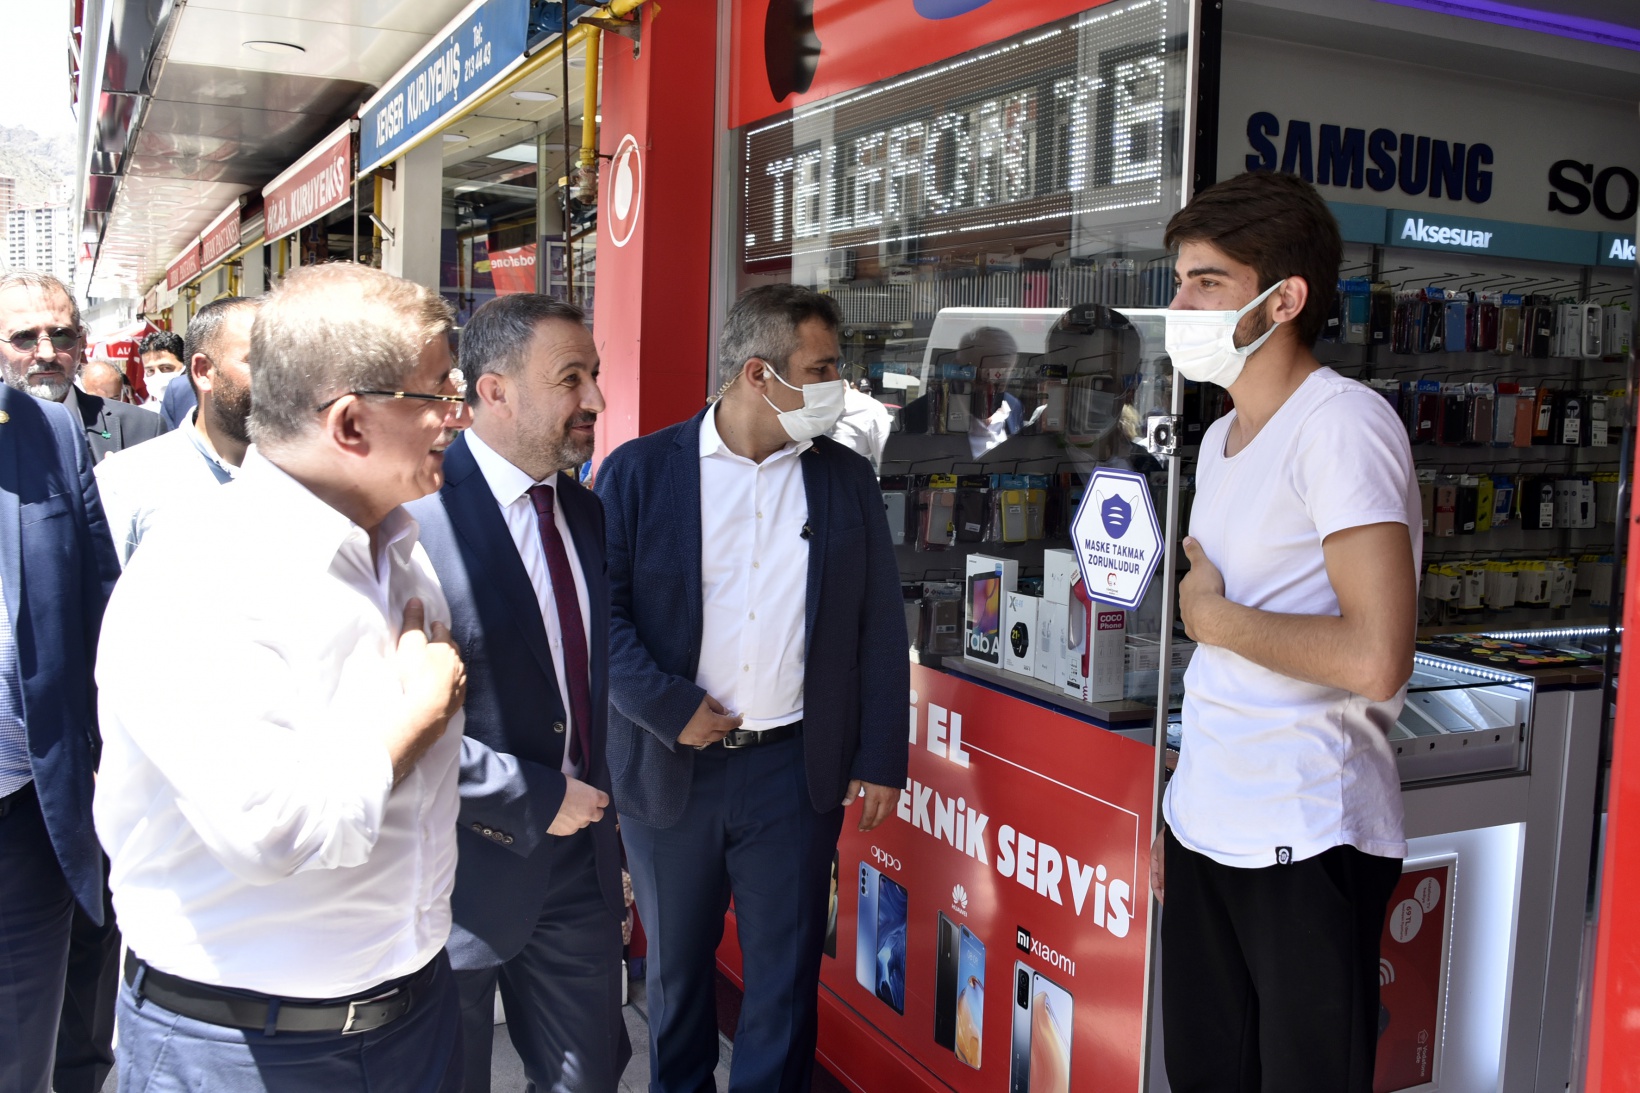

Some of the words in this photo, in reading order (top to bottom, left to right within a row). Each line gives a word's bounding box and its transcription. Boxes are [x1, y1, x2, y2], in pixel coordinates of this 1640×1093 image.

[376, 92, 404, 148] KEVSER
[407, 36, 461, 124] KURUYEMİŞ
[1245, 111, 1494, 204] SAMSUNG
[1401, 218, 1493, 249] Aksesuar
[1084, 539, 1111, 554] MASKE
[1112, 544, 1145, 561] TAKMAK
[1088, 554, 1140, 575] ZORUNLUDUR
[1100, 613, 1123, 623] COCO
[966, 629, 990, 654] Tab
[927, 702, 970, 769] EL
[951, 903, 968, 917] HUAWEI
